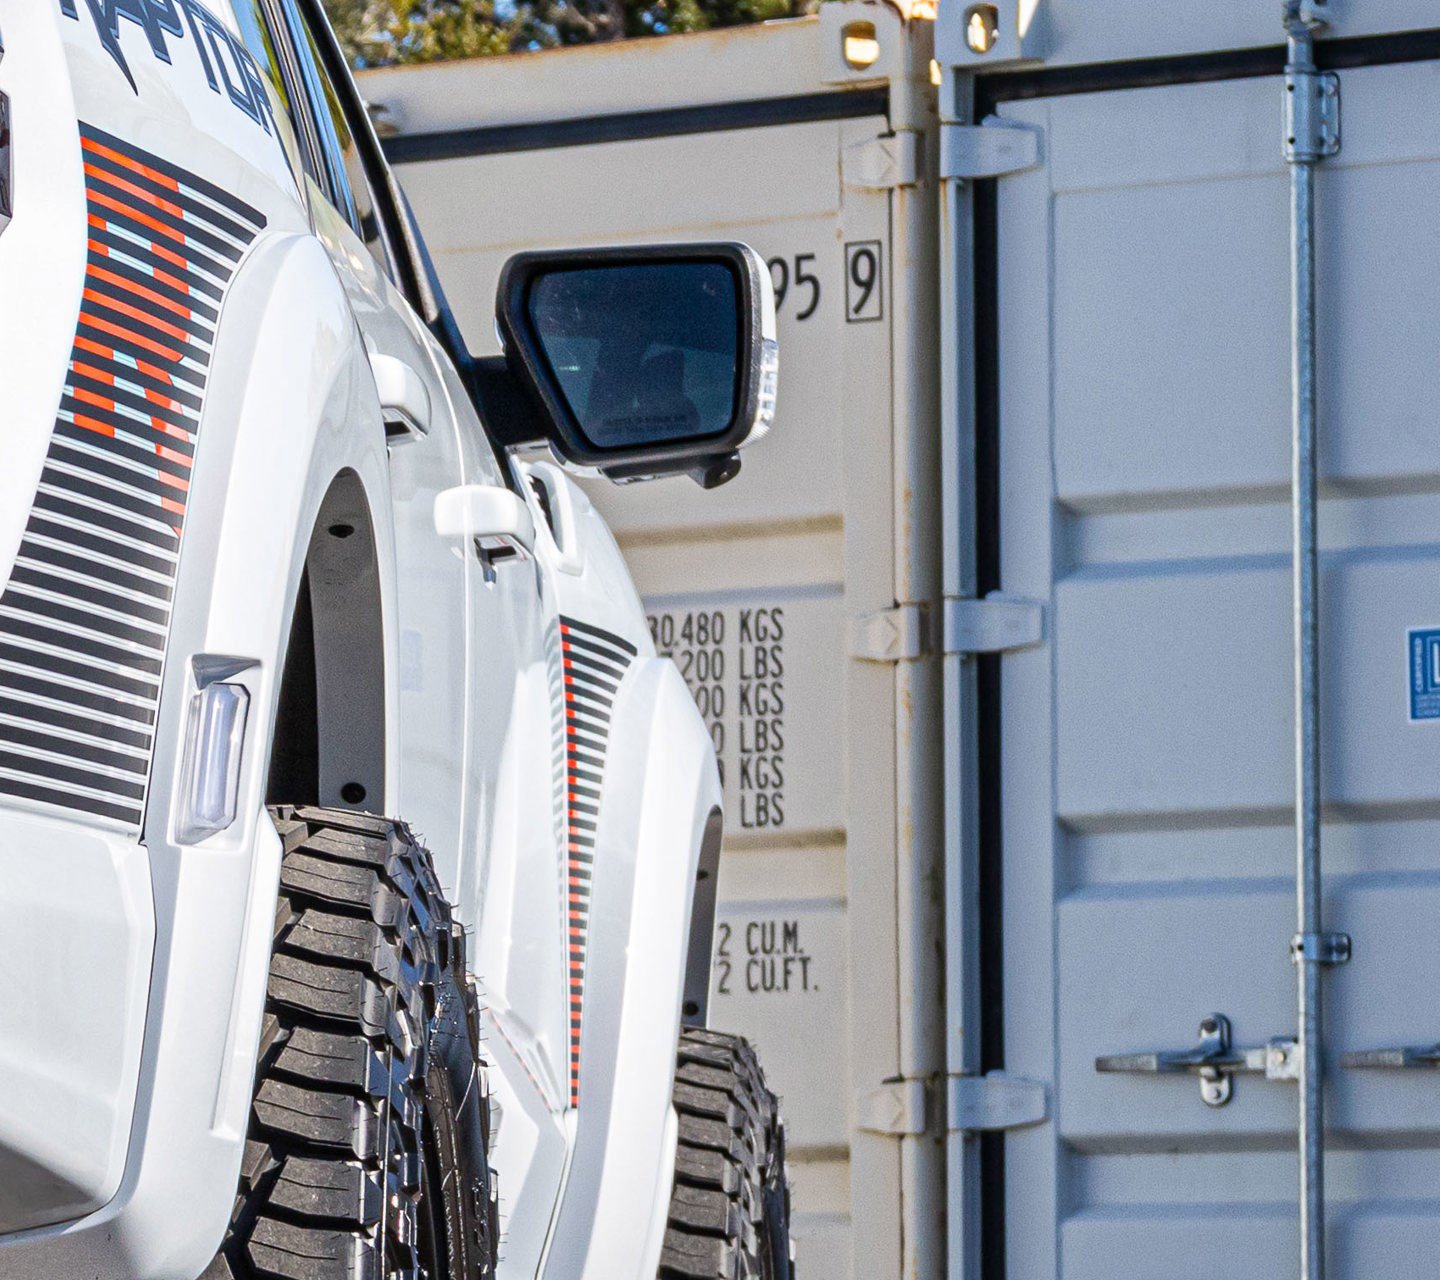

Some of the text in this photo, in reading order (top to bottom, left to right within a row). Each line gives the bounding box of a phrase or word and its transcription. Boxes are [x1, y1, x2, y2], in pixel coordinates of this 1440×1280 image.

[850, 247, 878, 316] 9
[739, 608, 783, 644] KGS
[739, 645, 784, 681] LBS
[739, 682, 784, 717] KGS
[740, 719, 784, 754] LBS
[740, 756, 784, 790] KGS
[740, 793, 784, 827] LBS
[746, 921, 804, 955] CU.M.
[746, 957, 819, 993] CU.FT.
